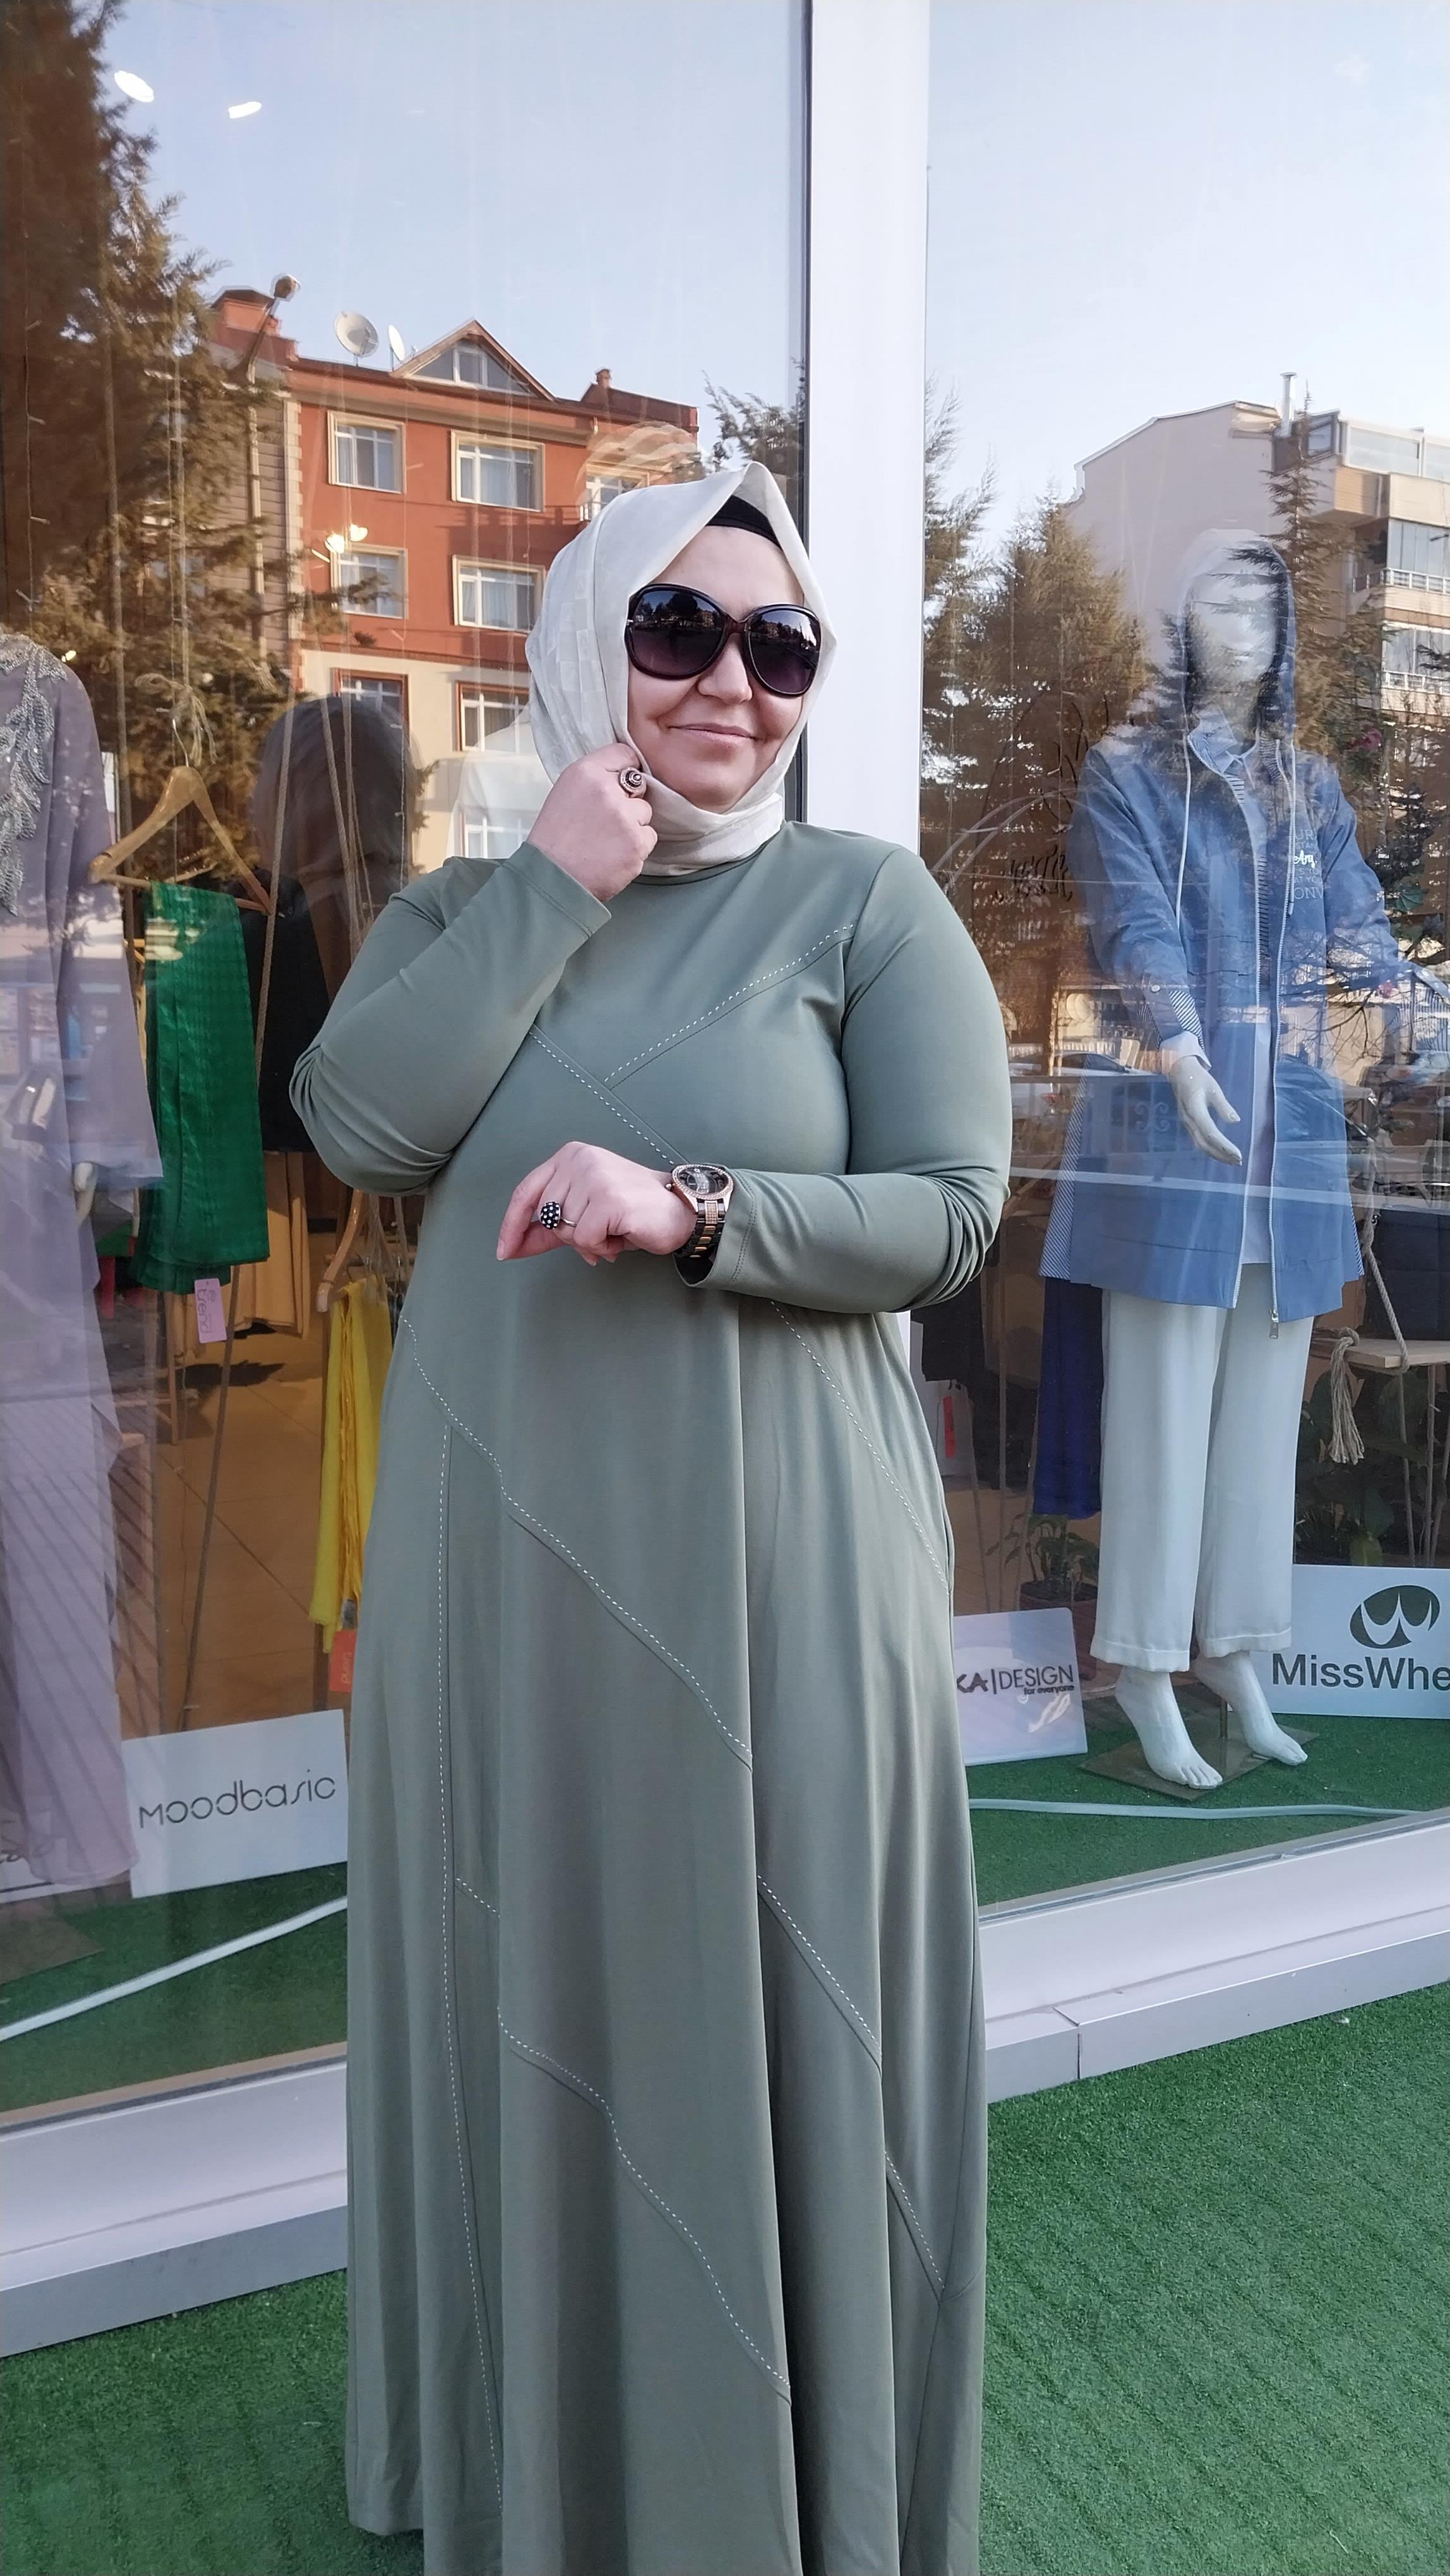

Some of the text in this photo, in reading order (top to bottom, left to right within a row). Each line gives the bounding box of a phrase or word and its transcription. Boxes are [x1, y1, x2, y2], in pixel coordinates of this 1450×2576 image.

[998, 1664, 1074, 1690] DESIGN
[1273, 1653, 1450, 1691] MissWhe
[1024, 1685, 1075, 1695] for everyone
